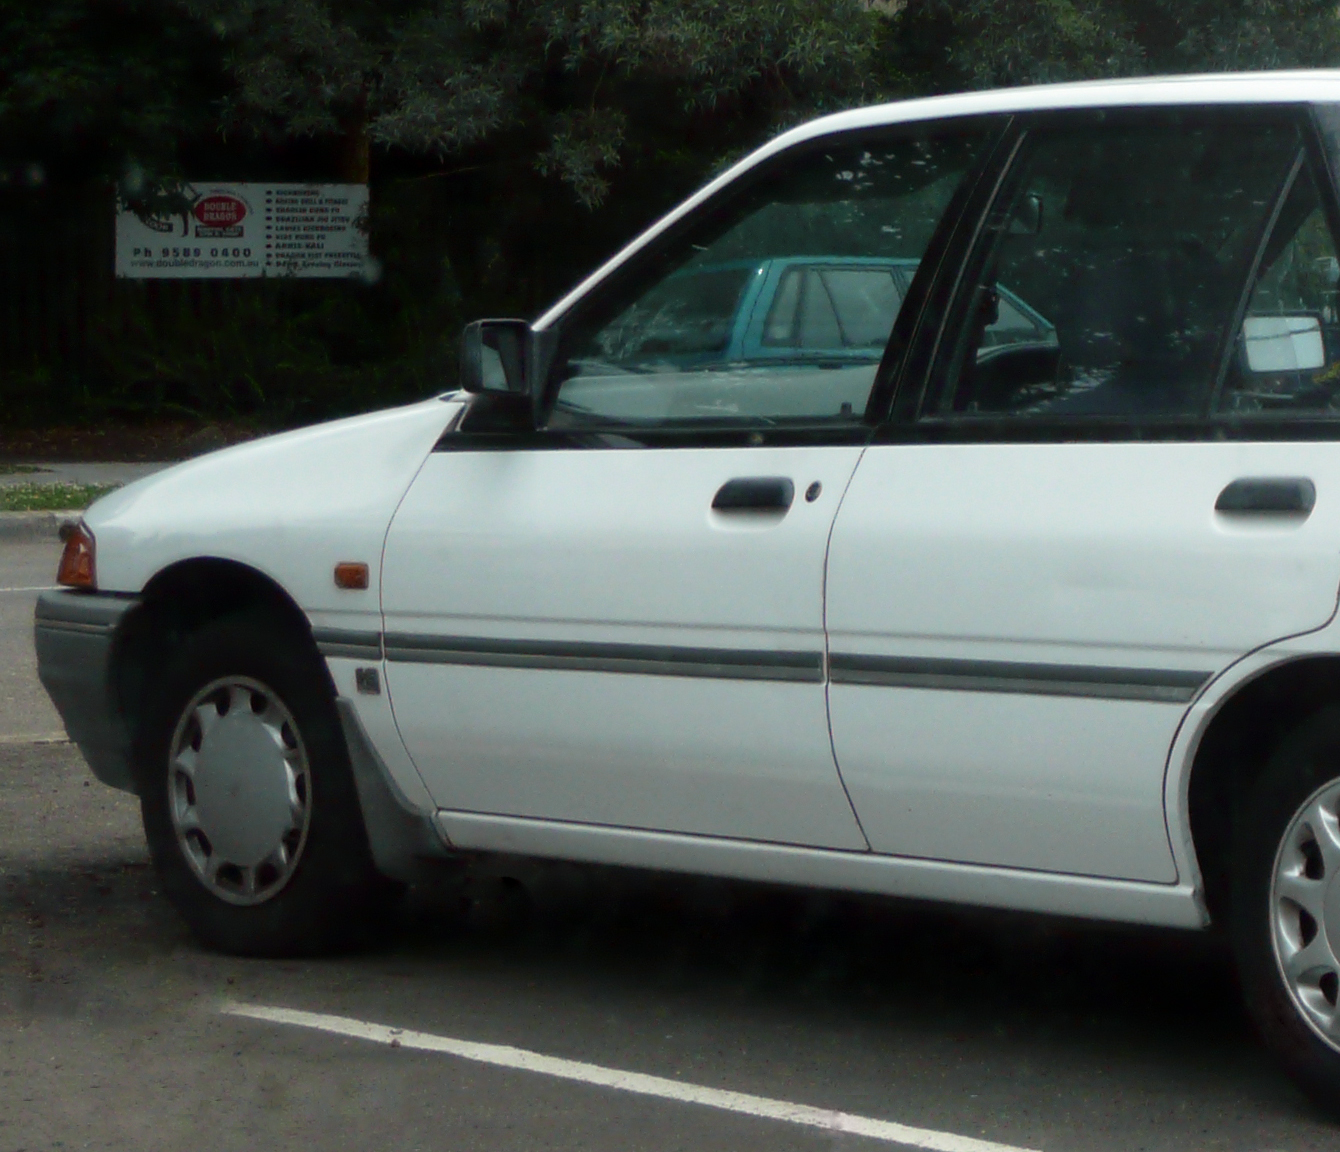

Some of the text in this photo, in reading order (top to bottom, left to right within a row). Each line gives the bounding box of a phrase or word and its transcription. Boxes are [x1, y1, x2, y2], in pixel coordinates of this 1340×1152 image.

[204, 201, 237, 211] DOUBLE
[203, 211, 238, 221] DRAGON
[133, 247, 252, 258] Ph 9589 0400
[130, 259, 260, 270] www.doubledragon.com.au
